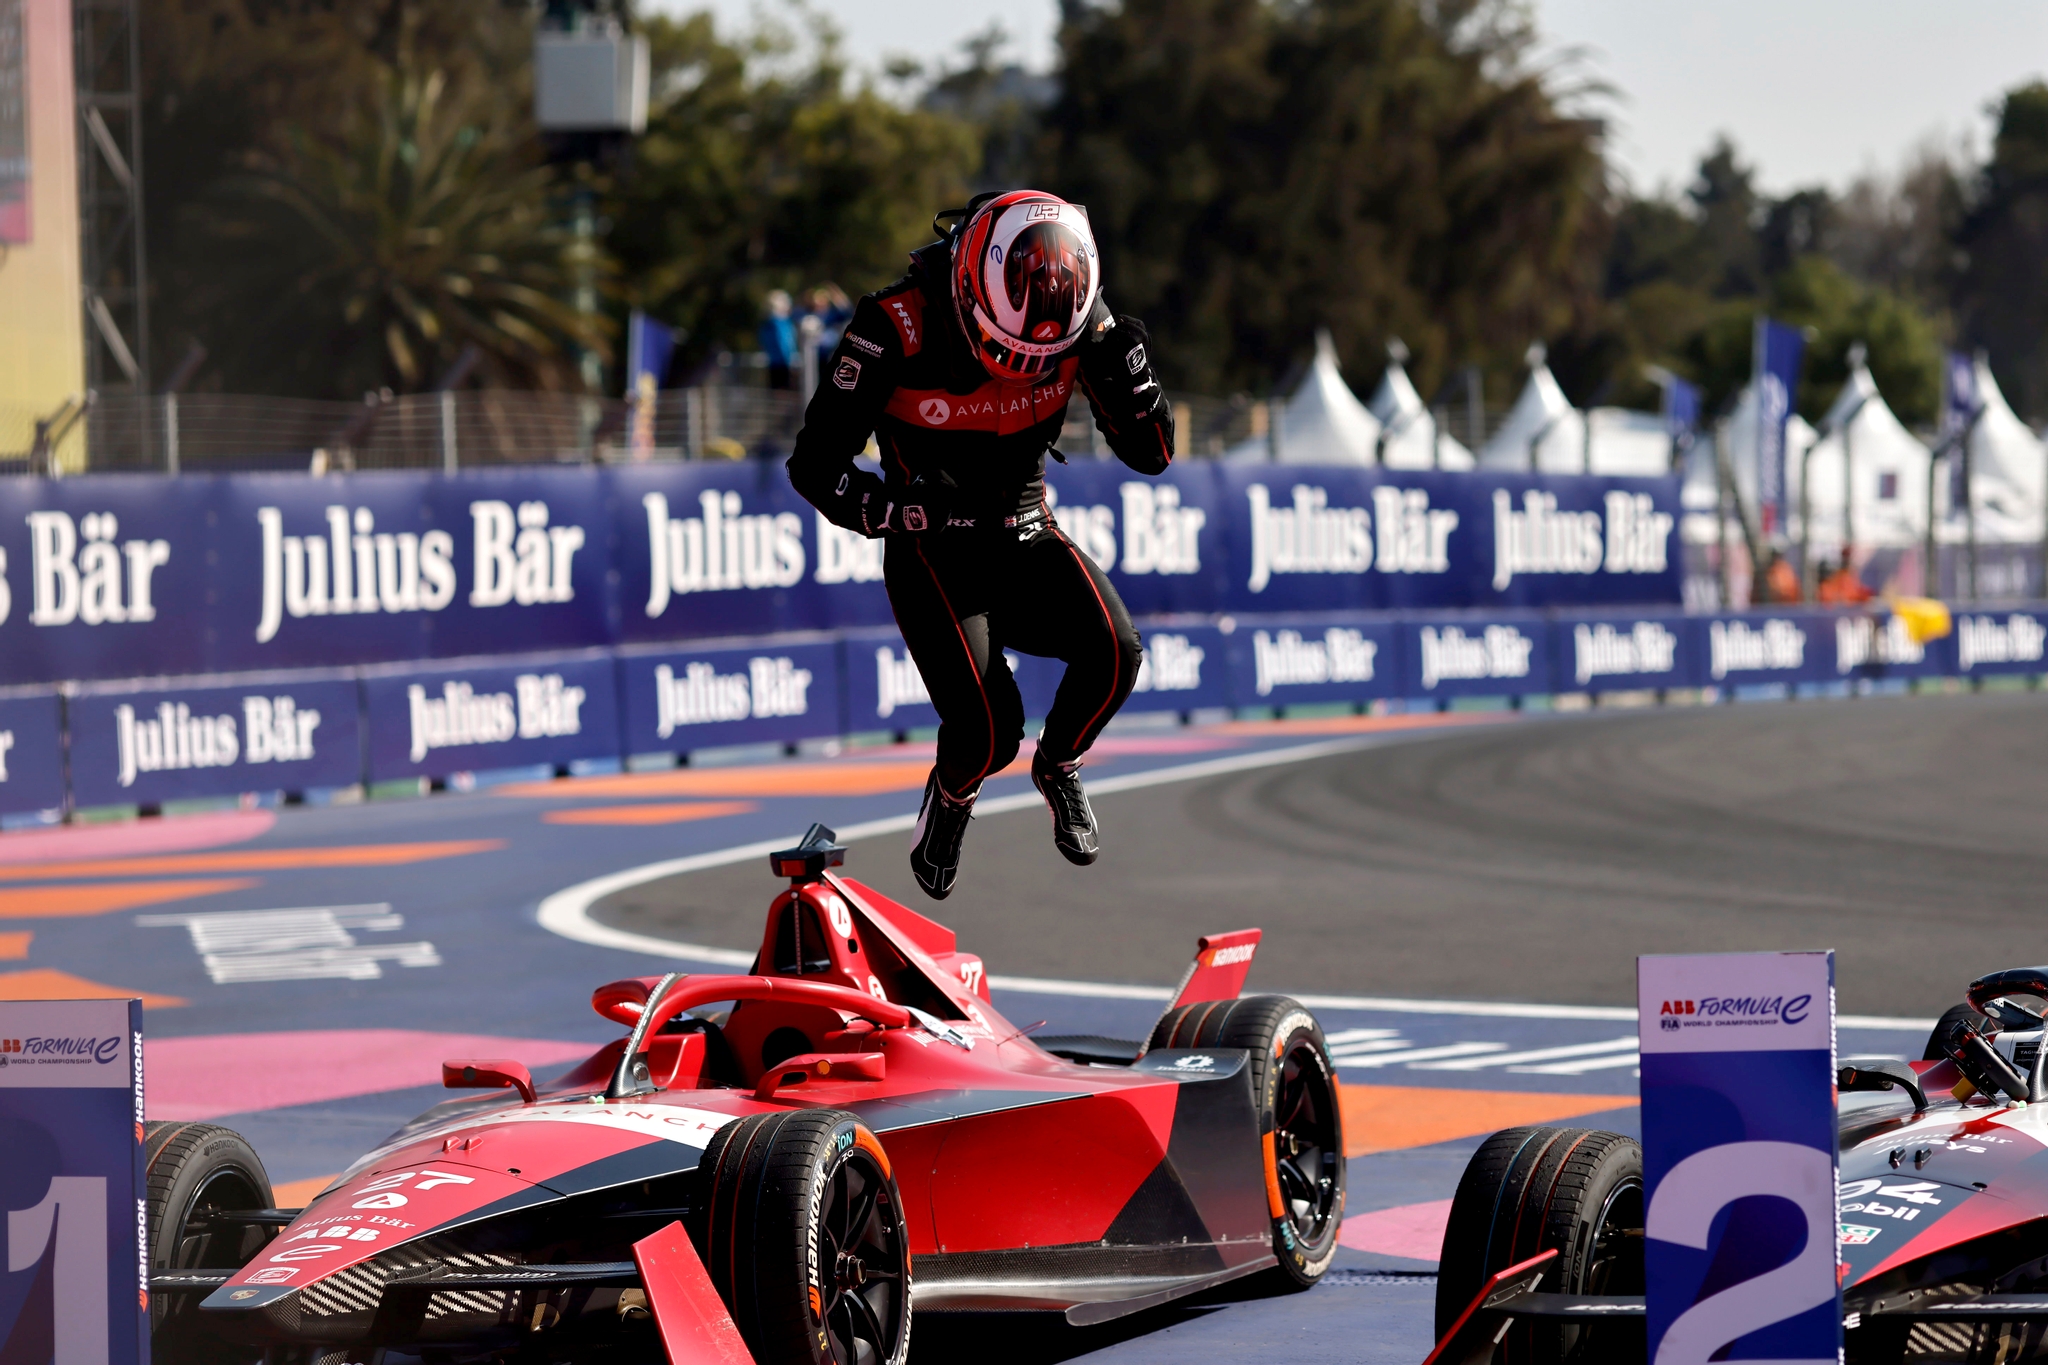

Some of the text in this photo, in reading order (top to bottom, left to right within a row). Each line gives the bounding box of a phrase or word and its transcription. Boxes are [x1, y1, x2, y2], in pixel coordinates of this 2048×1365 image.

[1002, 337, 1075, 354] AVALANCHE
[956, 381, 1066, 417] AVALANCHE
[25, 511, 171, 627] Bär
[643, 489, 806, 619] Julius
[1120, 481, 1206, 575] Bär
[1246, 483, 1460, 594] Julius Bär
[1492, 487, 1674, 592] Julius Bär
[256, 500, 586, 643] Julius Bär
[1149, 633, 1205, 692] Bär
[1253, 626, 1378, 697] Julius Bär
[1419, 623, 1533, 690] Julius Bär
[1574, 622, 1636, 686] Julius
[408, 673, 586, 763] Julius Bär
[653, 655, 813, 740] Julius Bär
[116, 694, 322, 788] Julius Bär
[22, 1036, 97, 1056] FORMULA
[1660, 999, 1696, 1016] ABB
[1697, 995, 1783, 1017] FORMULA
[1683, 1020, 1713, 1028] WORLD
[1715, 1019, 1779, 1027] CHAMPIONSHIP
[134, 1030, 144, 1124] HANKOOK
[294, 1214, 416, 1232] Julius Bär
[351, 1169, 476, 1197] 27
[807, 1163, 827, 1288] HANKOOK
[1840, 1201, 1921, 1221] obil
[8, 1176, 109, 1365] 1
[137, 1198, 148, 1291] HANKOOK
[283, 1225, 381, 1244] ABB
[1646, 1140, 1836, 1365] 2
